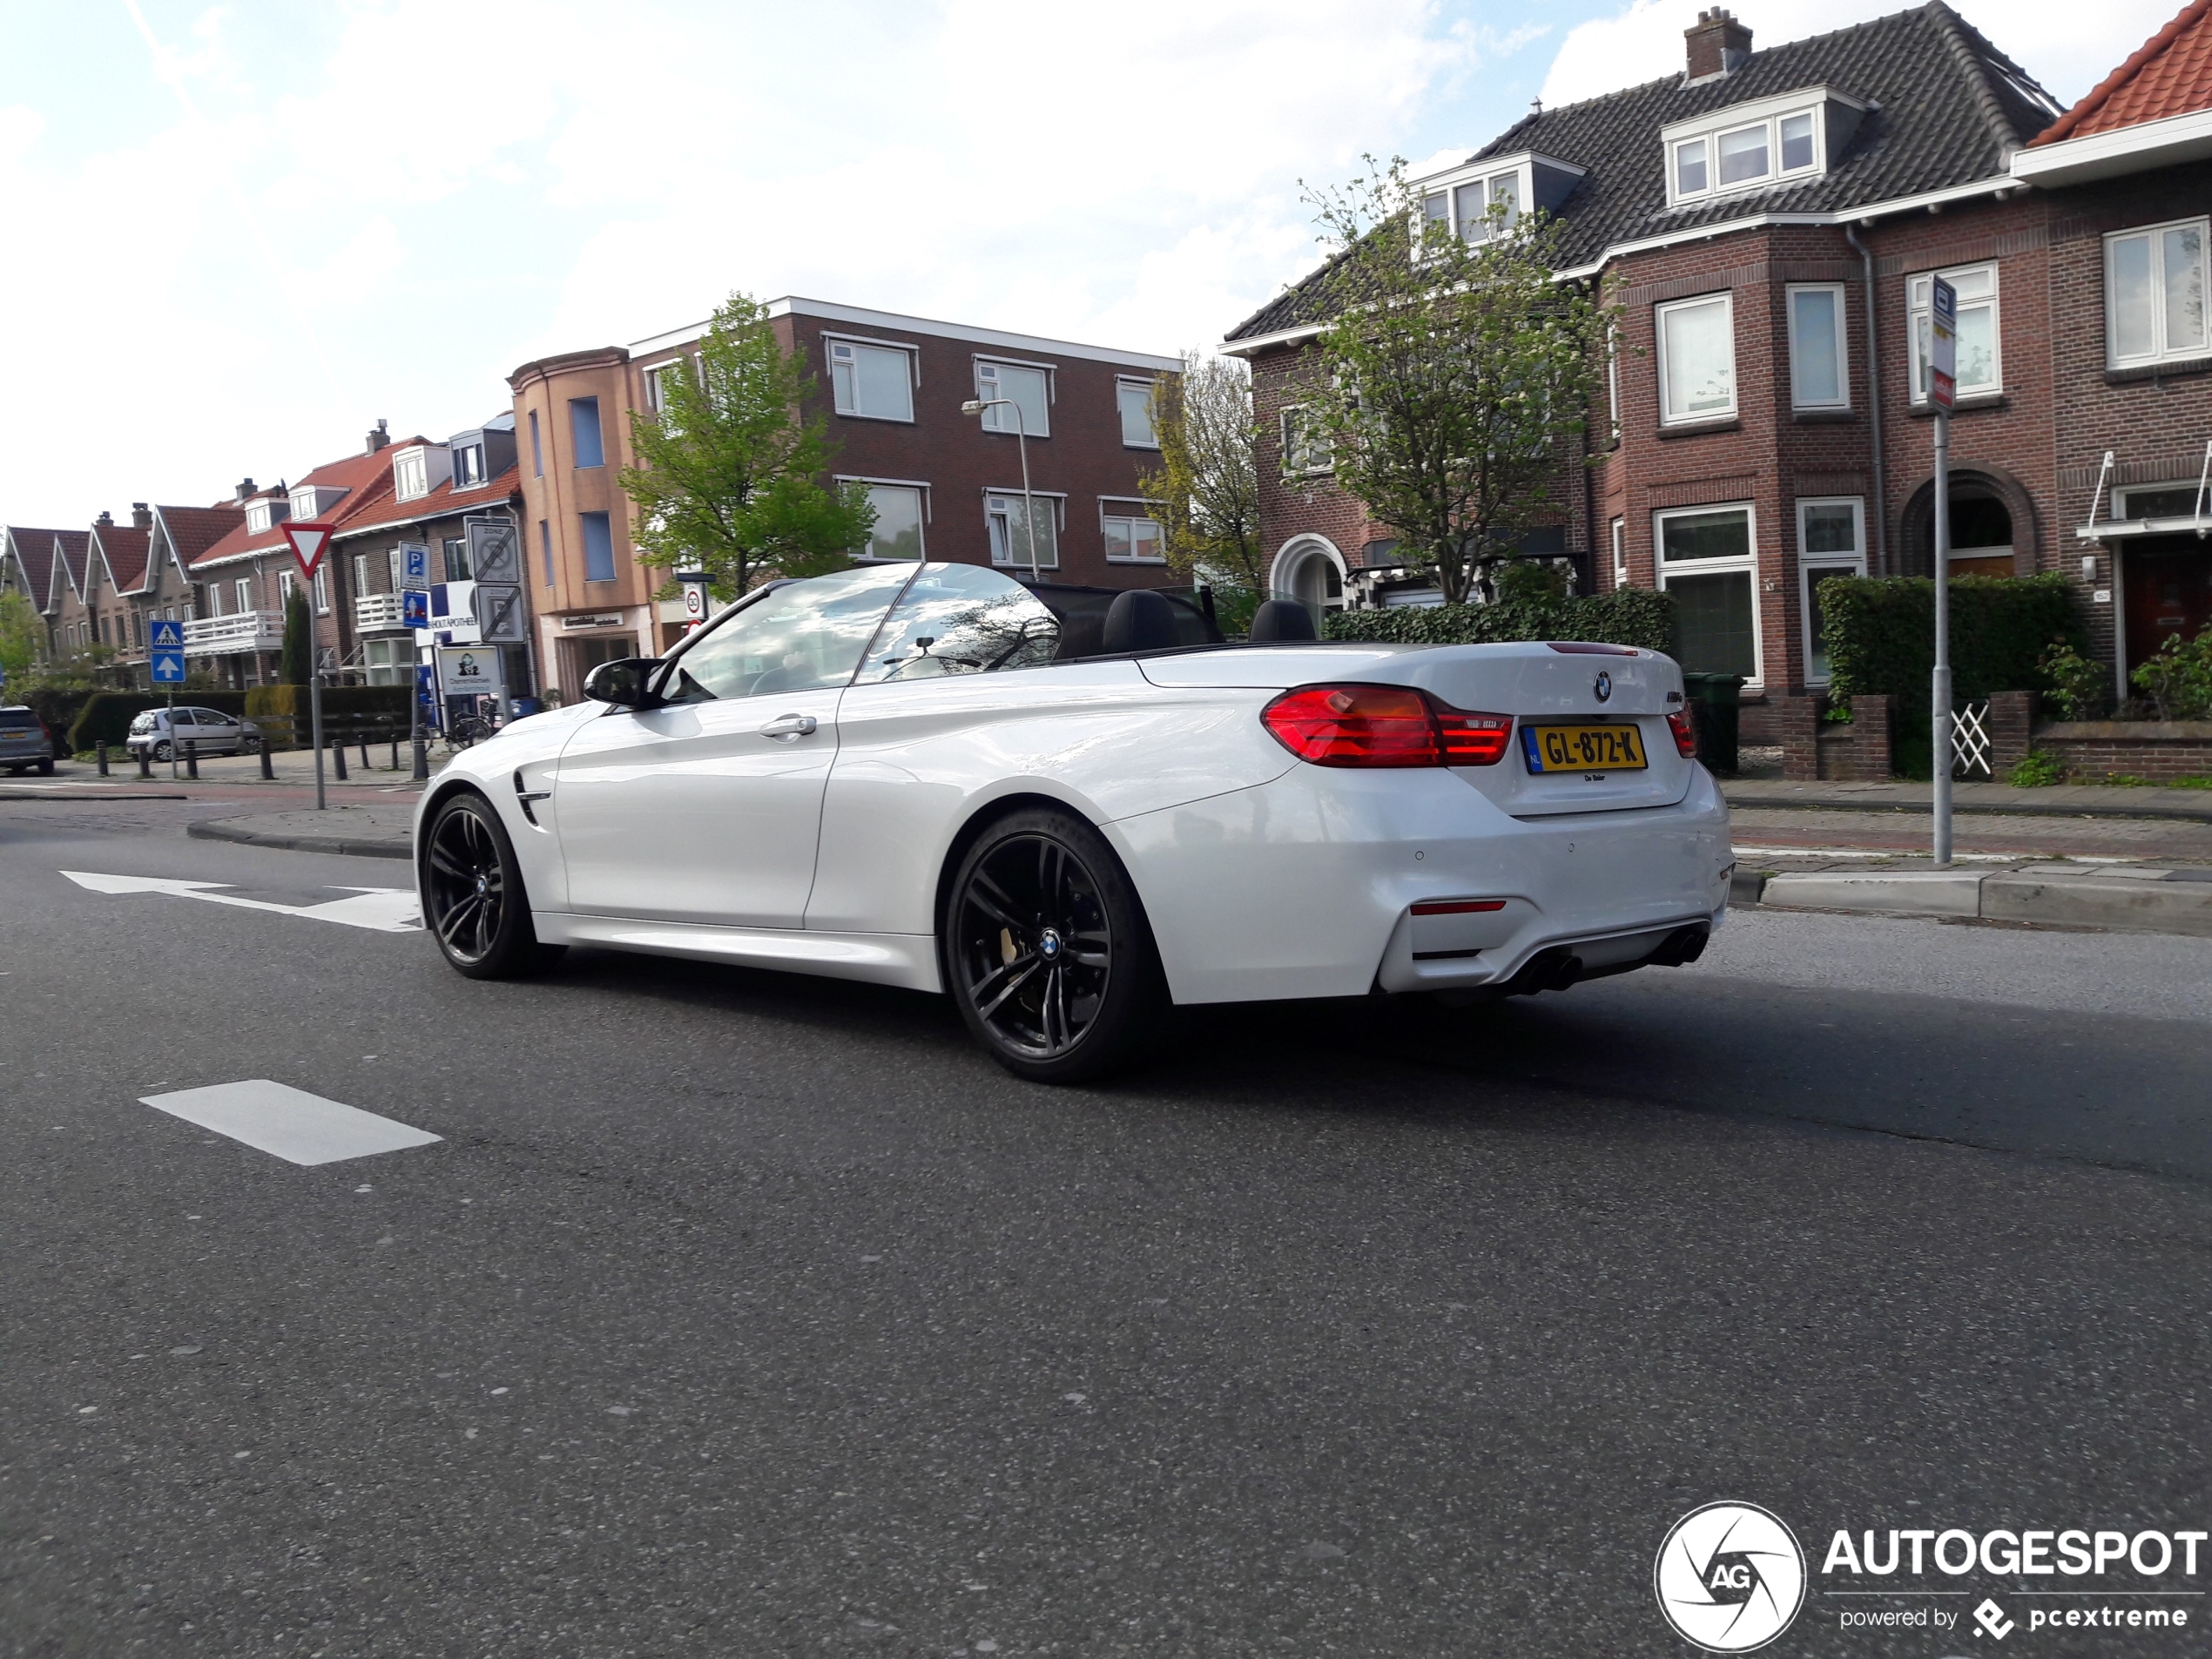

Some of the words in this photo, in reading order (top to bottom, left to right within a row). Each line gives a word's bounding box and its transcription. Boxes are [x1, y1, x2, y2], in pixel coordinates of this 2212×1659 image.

[410, 553, 421, 565] P
[689, 597, 698, 607] 30
[1546, 732, 1637, 765] GL-872-K
[1530, 754, 1541, 765] NL
